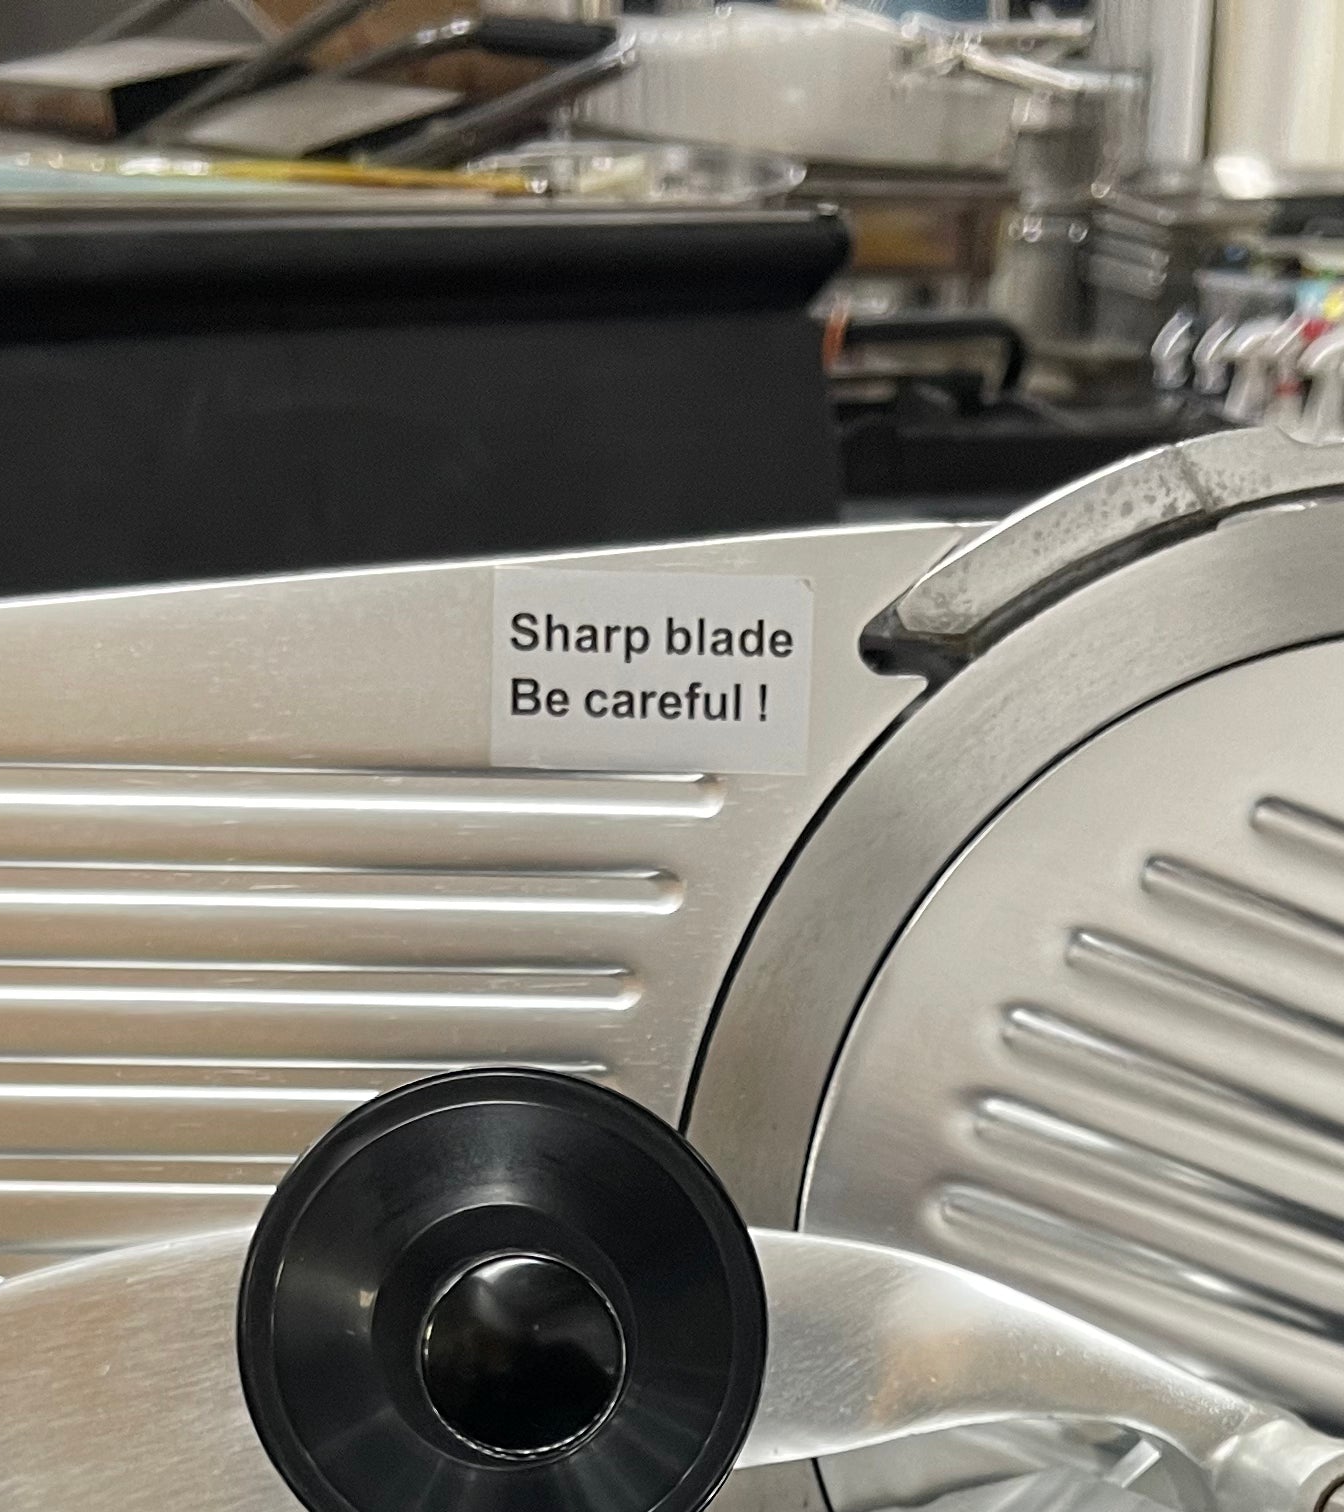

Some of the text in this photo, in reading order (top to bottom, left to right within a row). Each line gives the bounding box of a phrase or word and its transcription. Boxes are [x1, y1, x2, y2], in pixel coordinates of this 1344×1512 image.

[510, 612, 794, 664] Sharp blade
[511, 677, 570, 718] Be
[584, 681, 742, 721] careful
